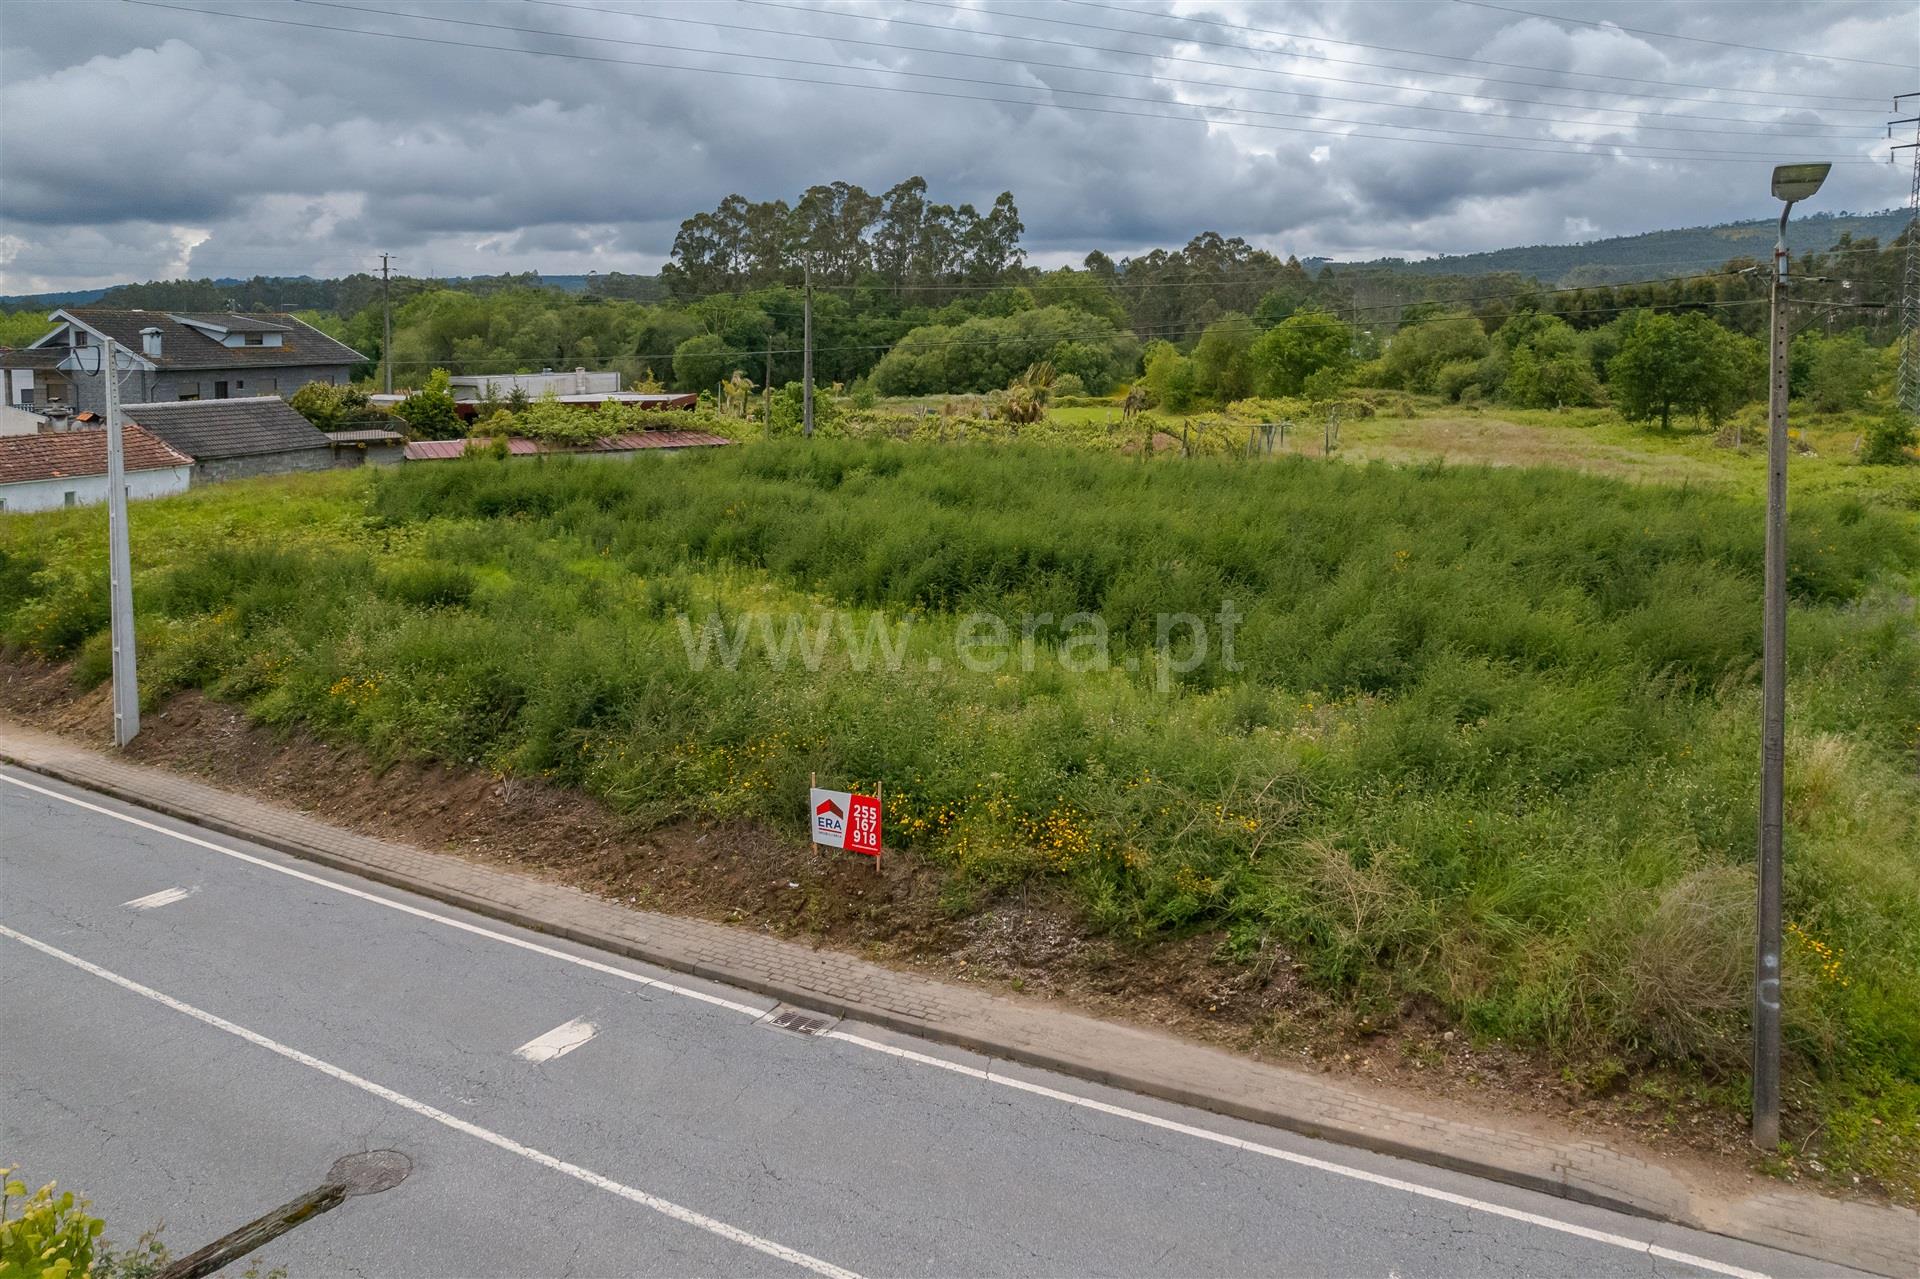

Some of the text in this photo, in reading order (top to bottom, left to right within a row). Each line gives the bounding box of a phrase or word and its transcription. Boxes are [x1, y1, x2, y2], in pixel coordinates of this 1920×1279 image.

[854, 805, 876, 820] 255
[818, 817, 842, 830] ERA
[855, 818, 876, 832] 167
[854, 830, 876, 845] 918
